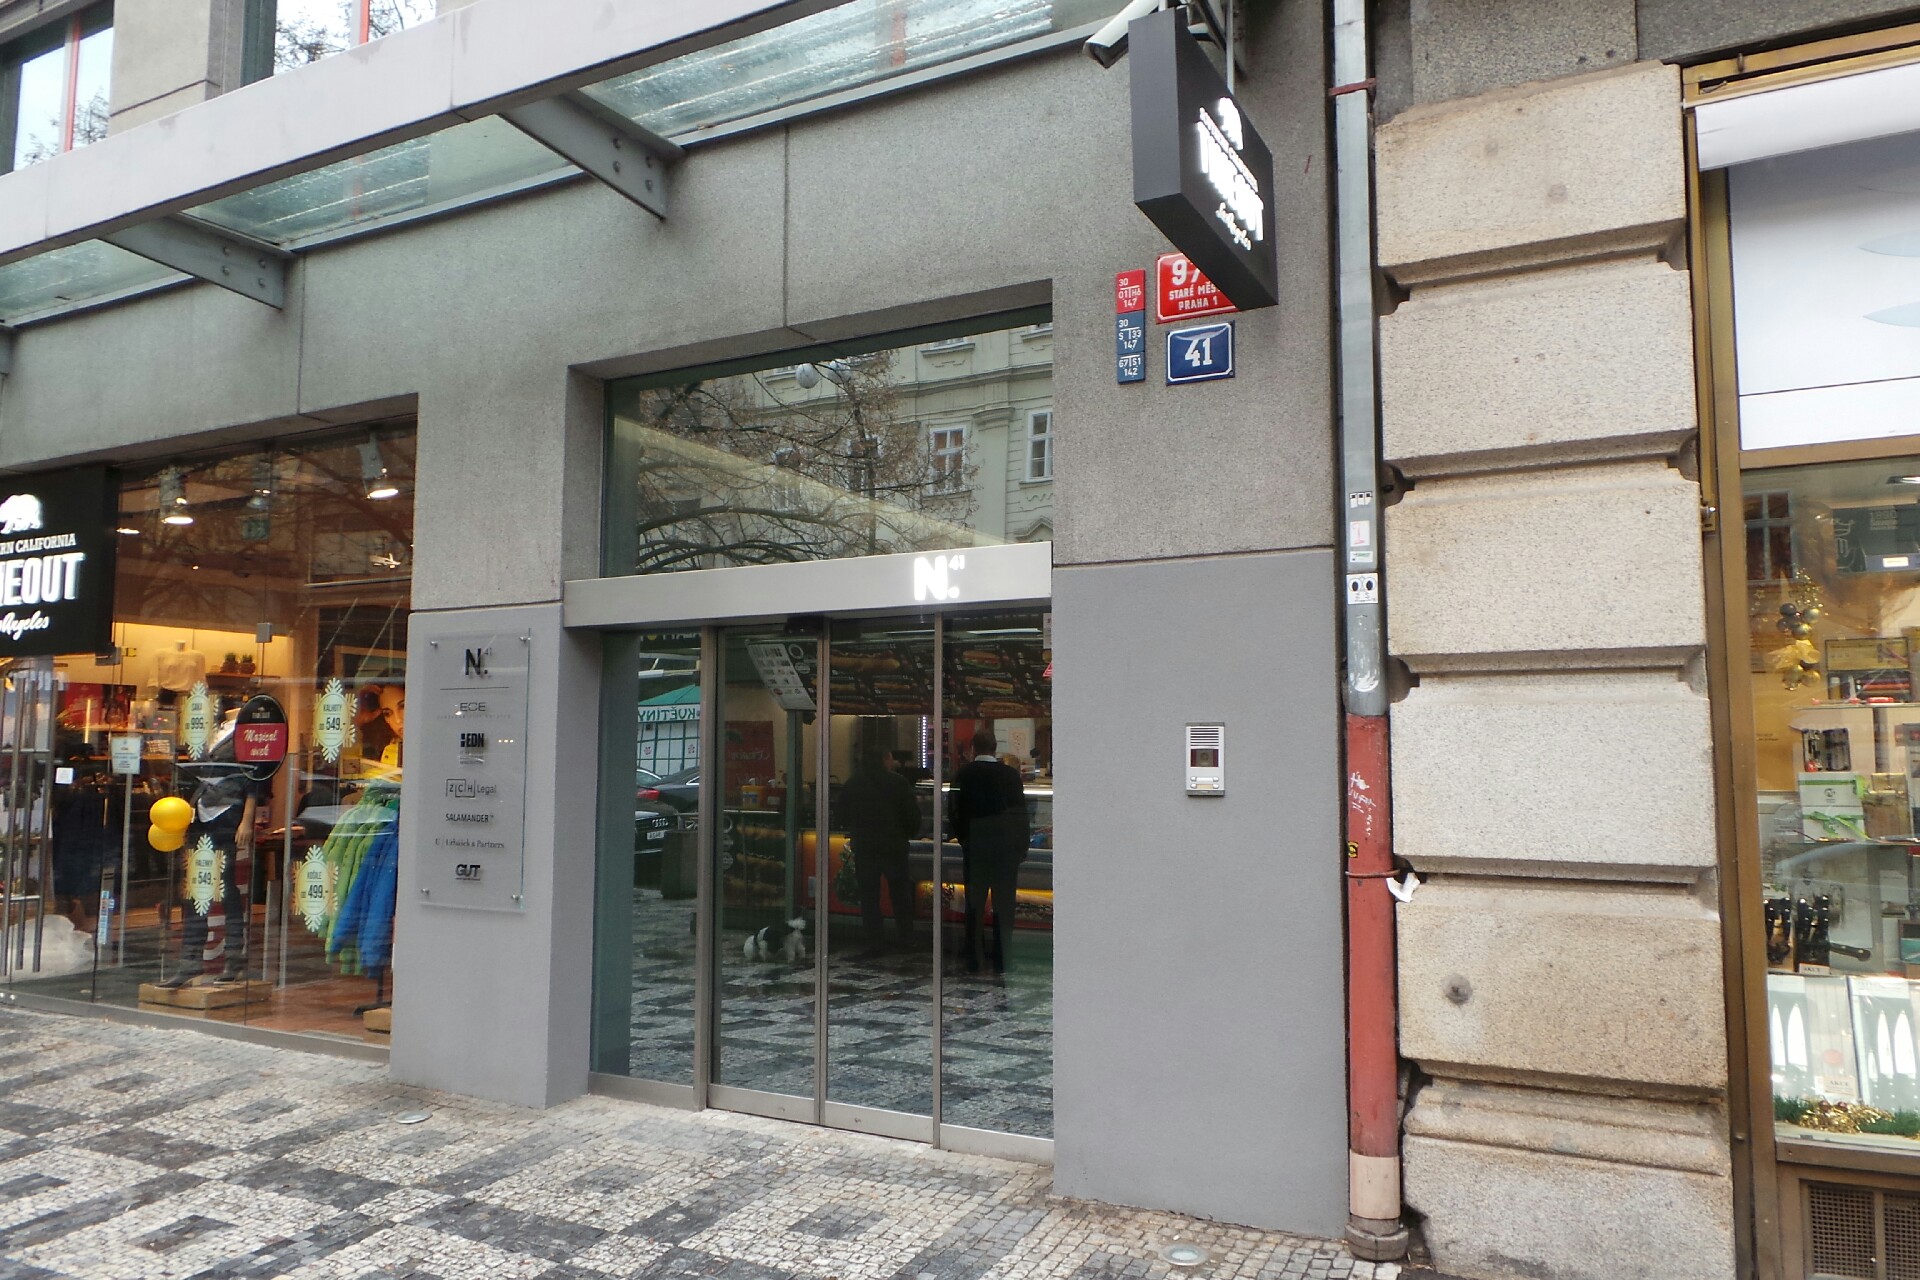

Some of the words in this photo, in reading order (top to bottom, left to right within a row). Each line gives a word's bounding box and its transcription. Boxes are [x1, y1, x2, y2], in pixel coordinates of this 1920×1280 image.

[1118, 278, 1129, 287] 30
[1169, 284, 1194, 300] STARÉ
[1178, 297, 1209, 311] PRAHA
[1212, 296, 1218, 306] 1
[1118, 319, 1129, 328] 30
[1184, 337, 1213, 368] 41
[15, 533, 77, 554] CALIFORNIA
[460, 702, 487, 711] ECE
[466, 733, 485, 748] EDN
[477, 784, 497, 796] Legal
[455, 863, 481, 878] GUT
